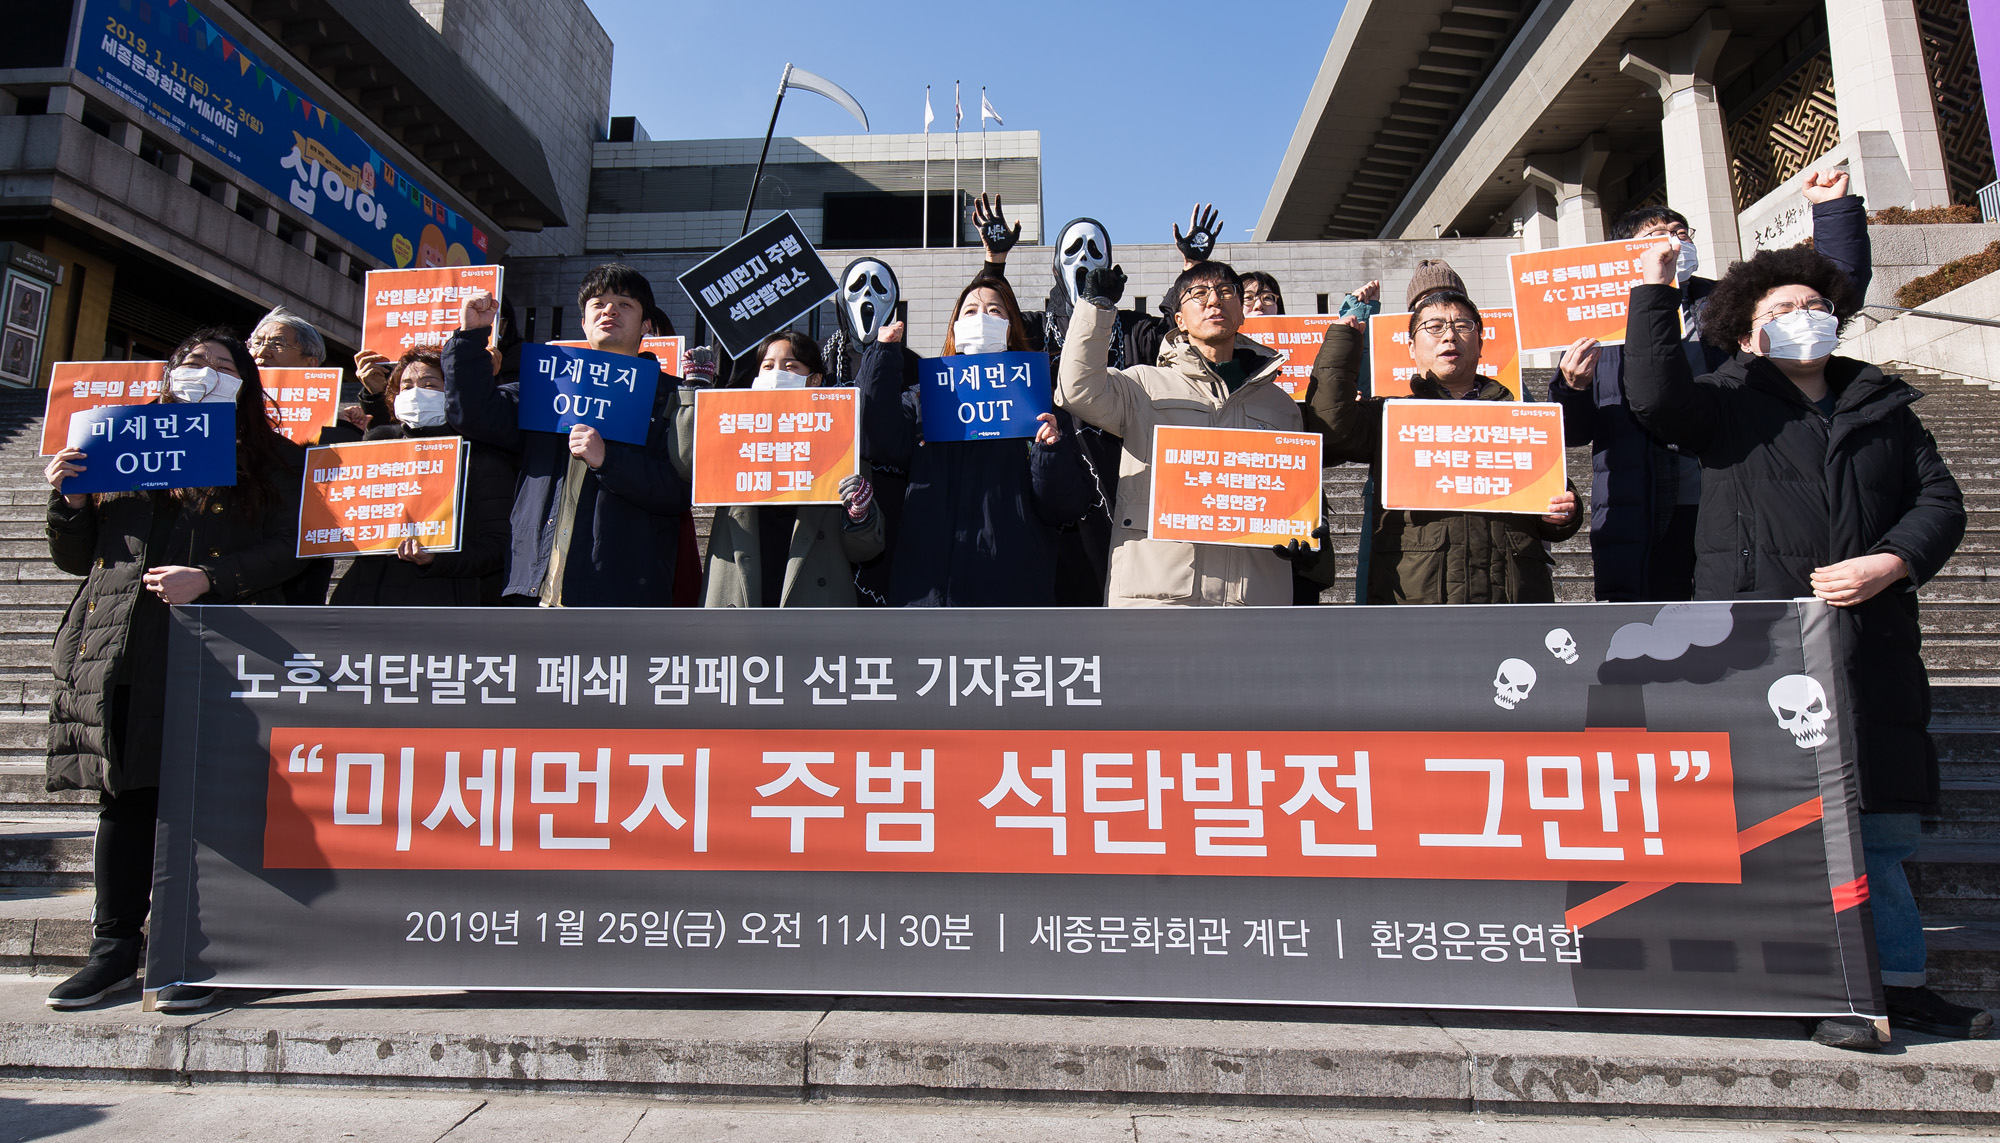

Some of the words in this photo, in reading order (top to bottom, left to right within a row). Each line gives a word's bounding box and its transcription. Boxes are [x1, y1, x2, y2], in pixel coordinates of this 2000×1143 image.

[101, 34, 187, 104] 세종문화회관
[106, 16, 149, 57] 2019.
[154, 49, 166, 69] 1.
[170, 61, 209, 97] 11(금)
[223, 99, 235, 115] 2.
[238, 108, 264, 135] 3(일)
[280, 146, 387, 230] 십이야
[988, 224, 1006, 242] 석탄
[700, 255, 768, 308] 미세먼지
[765, 234, 802, 264] 주범
[1520, 270, 1550, 286] 석탄
[1599, 260, 1630, 276] 빠진
[729, 266, 810, 322] 석탄발전소
[386, 310, 428, 328] 탈석탄
[430, 308, 461, 325] 로드
[1567, 302, 1627, 322] 불러온다
[1278, 332, 1323, 344] 미세먼지
[538, 356, 638, 392] 미세먼지
[936, 362, 1032, 392] 미세먼지
[72, 380, 124, 398] 침묵의
[128, 380, 162, 397] 살인
[280, 388, 304, 402] 빠진
[306, 386, 330, 402] 한국
[553, 394, 612, 420] OUT
[958, 400, 1013, 424] OUT
[91, 414, 210, 442] 미세먼지
[718, 413, 772, 434] 침묵의
[778, 412, 834, 432] 살인자
[1398, 425, 1548, 444] 산업통상자원부는
[116, 450, 186, 474] OUT
[738, 442, 810, 462] 석탄발전
[1165, 449, 1219, 466] 미세먼지
[1223, 452, 1306, 470] 감축한다면서
[1414, 450, 1470, 468] 탈석탄
[1475, 452, 1532, 470] 로드맵
[314, 465, 363, 484] 미세먼지
[366, 460, 444, 480] 감축한다면서
[736, 472, 772, 492] 이제
[776, 470, 814, 491] 그만
[1184, 471, 1212, 486] 노후
[1216, 472, 1286, 491] 석탄발전소
[330, 486, 356, 502] 노후
[358, 481, 422, 499] 석탄발전소
[1436, 476, 1512, 495] 수립하라
[344, 503, 404, 520] 수명연장?
[1202, 494, 1266, 512] 수명연장?
[305, 528, 355, 544] 석탄발전
[358, 524, 384, 541] 조기
[387, 520, 446, 539] 폐쇄하라!
[1158, 513, 1214, 530] 석탄발전
[1218, 516, 1245, 532] 조기
[1250, 518, 1312, 536] 폐쇄하라!
[230, 653, 516, 705] 노후석탄발전
[537, 655, 628, 706] 폐쇄
[647, 655, 784, 706] 캠페인
[804, 656, 898, 706] 선포
[916, 655, 1102, 706] 기자회견
[288, 743, 710, 852] “미세먼지
[751, 748, 935, 853] 주범
[978, 749, 1378, 857] 석탄발전
[1418, 750, 1711, 861] 그만!”
[405, 910, 519, 946] 2019년
[536, 910, 585, 946] 1월
[596, 910, 726, 949] 25일(금)
[737, 912, 801, 949] 오전
[817, 913, 886, 950] 11시
[899, 913, 974, 950] 30분
[1030, 914, 1230, 956] 세종문화회관
[1243, 918, 1310, 958] 계단
[1370, 919, 1584, 964] 환경운동연합
